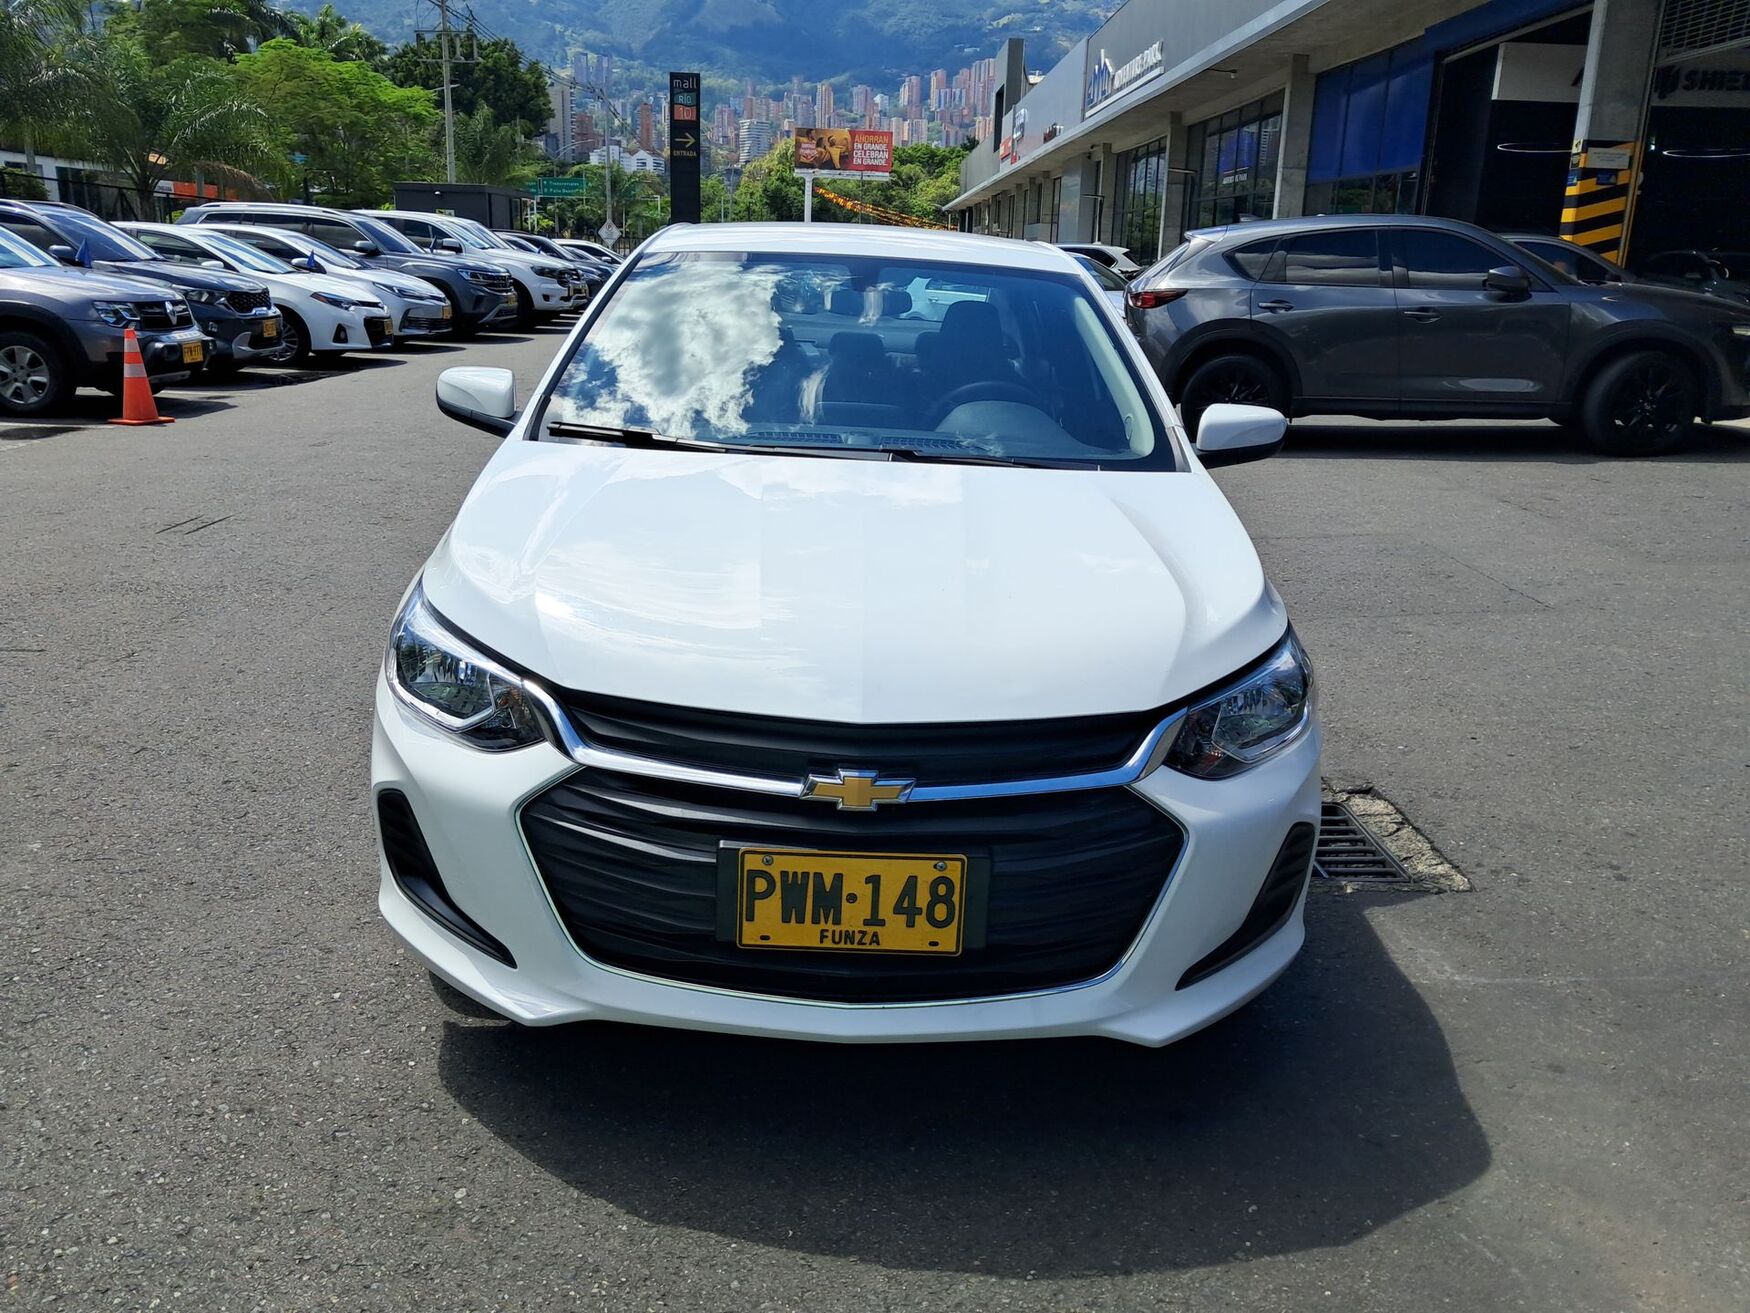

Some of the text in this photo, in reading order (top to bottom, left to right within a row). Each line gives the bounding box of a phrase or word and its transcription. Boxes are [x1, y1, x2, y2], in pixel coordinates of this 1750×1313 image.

[673, 77, 697, 89] mall
[855, 134, 889, 144] AHORRAN
[853, 142, 863, 150] EN
[853, 150, 889, 159] CELEBRAN
[853, 157, 862, 165] EN
[819, 929, 881, 946] FUNZA
